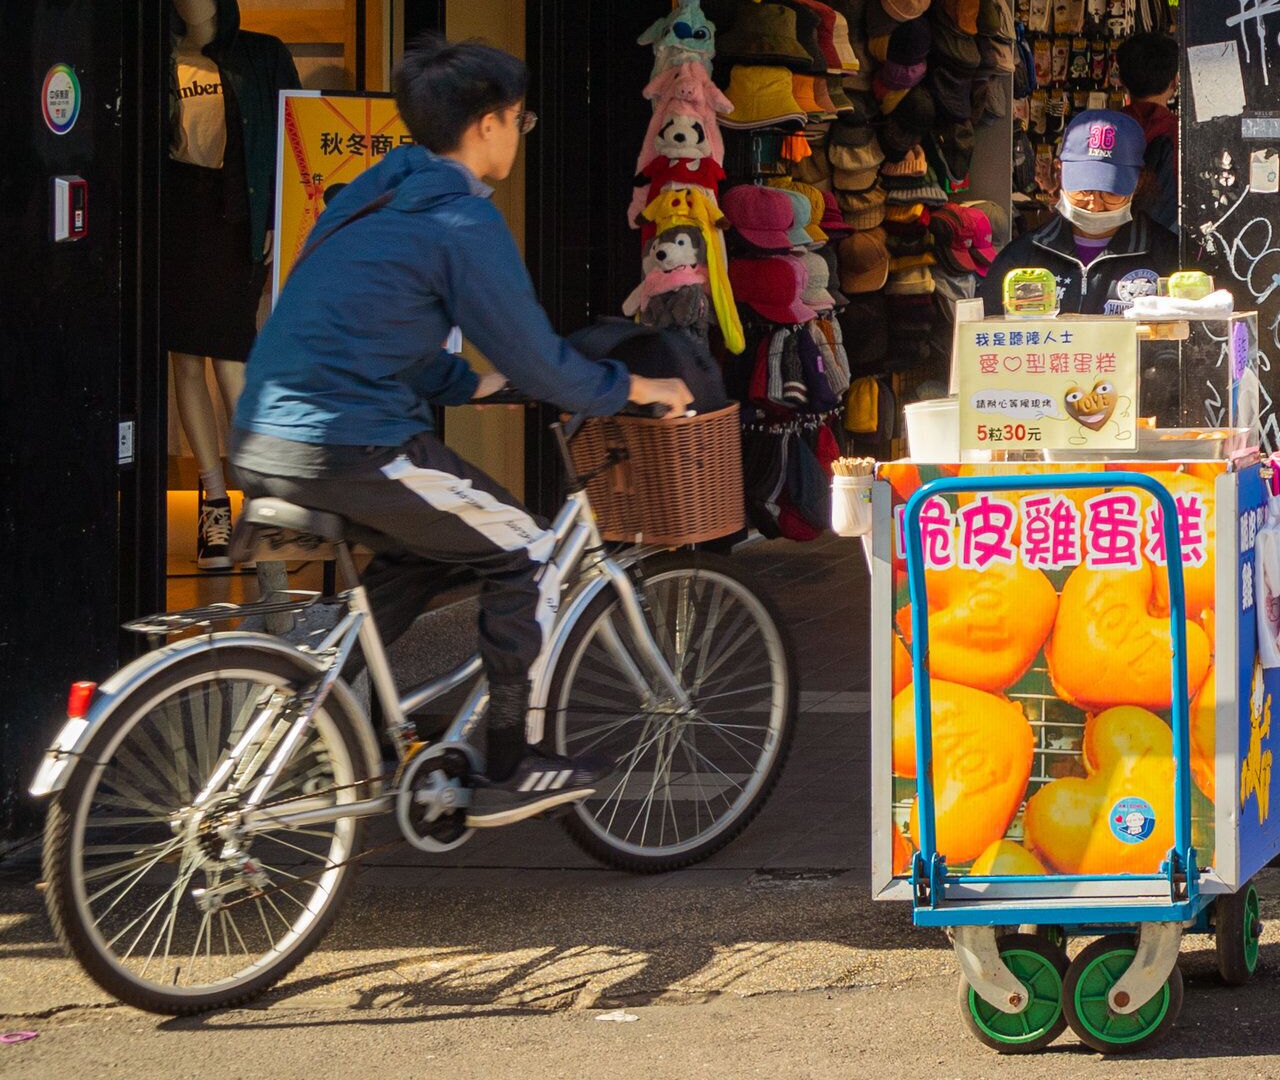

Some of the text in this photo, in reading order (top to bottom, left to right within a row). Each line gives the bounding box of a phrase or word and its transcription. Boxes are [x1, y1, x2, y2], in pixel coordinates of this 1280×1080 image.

[1088, 123, 1116, 150] 36
[1088, 149, 1113, 159] LYNX
[975, 330, 1074, 347] 我是聽障人士
[976, 423, 1042, 442] 5粒30元
